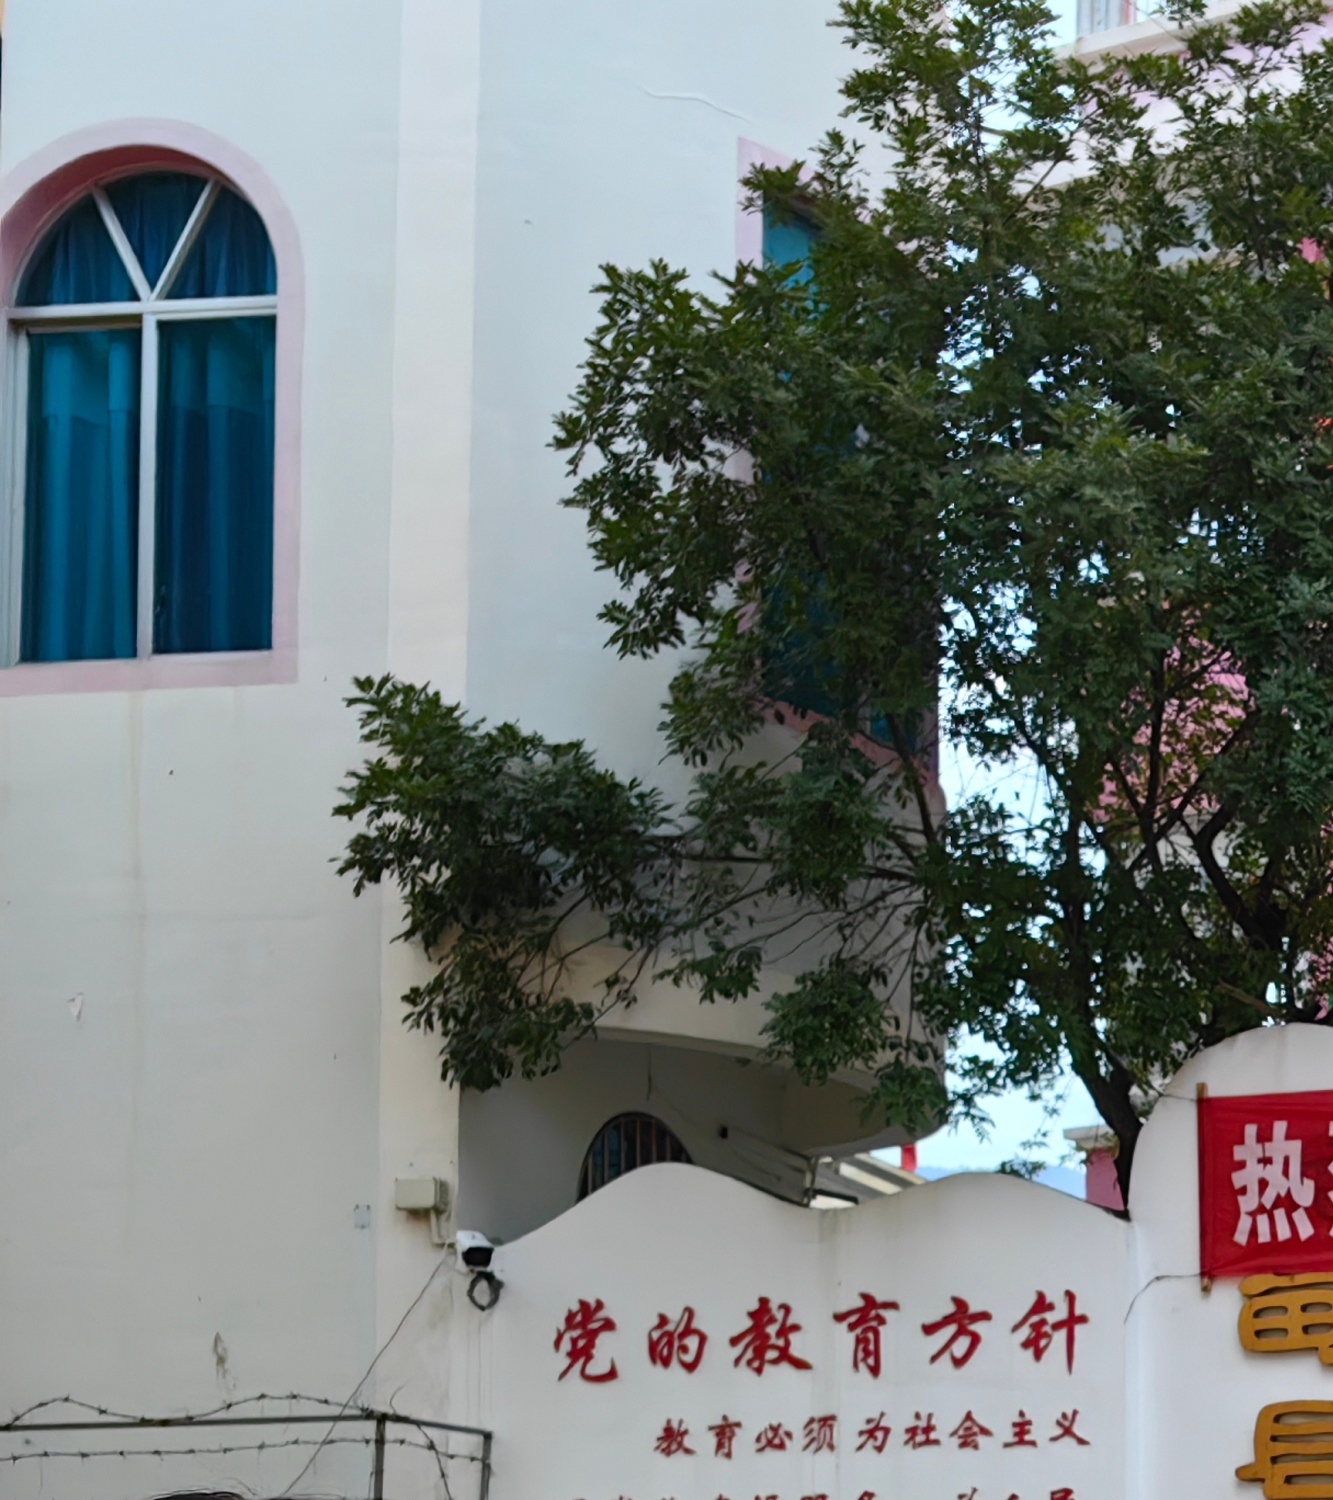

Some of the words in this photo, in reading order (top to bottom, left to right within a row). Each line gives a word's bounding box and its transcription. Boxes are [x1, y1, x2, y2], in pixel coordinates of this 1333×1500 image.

[554, 1289, 1090, 1384] 党的教育方针
[653, 1410, 1091, 1459] 教育必须为社会主义
